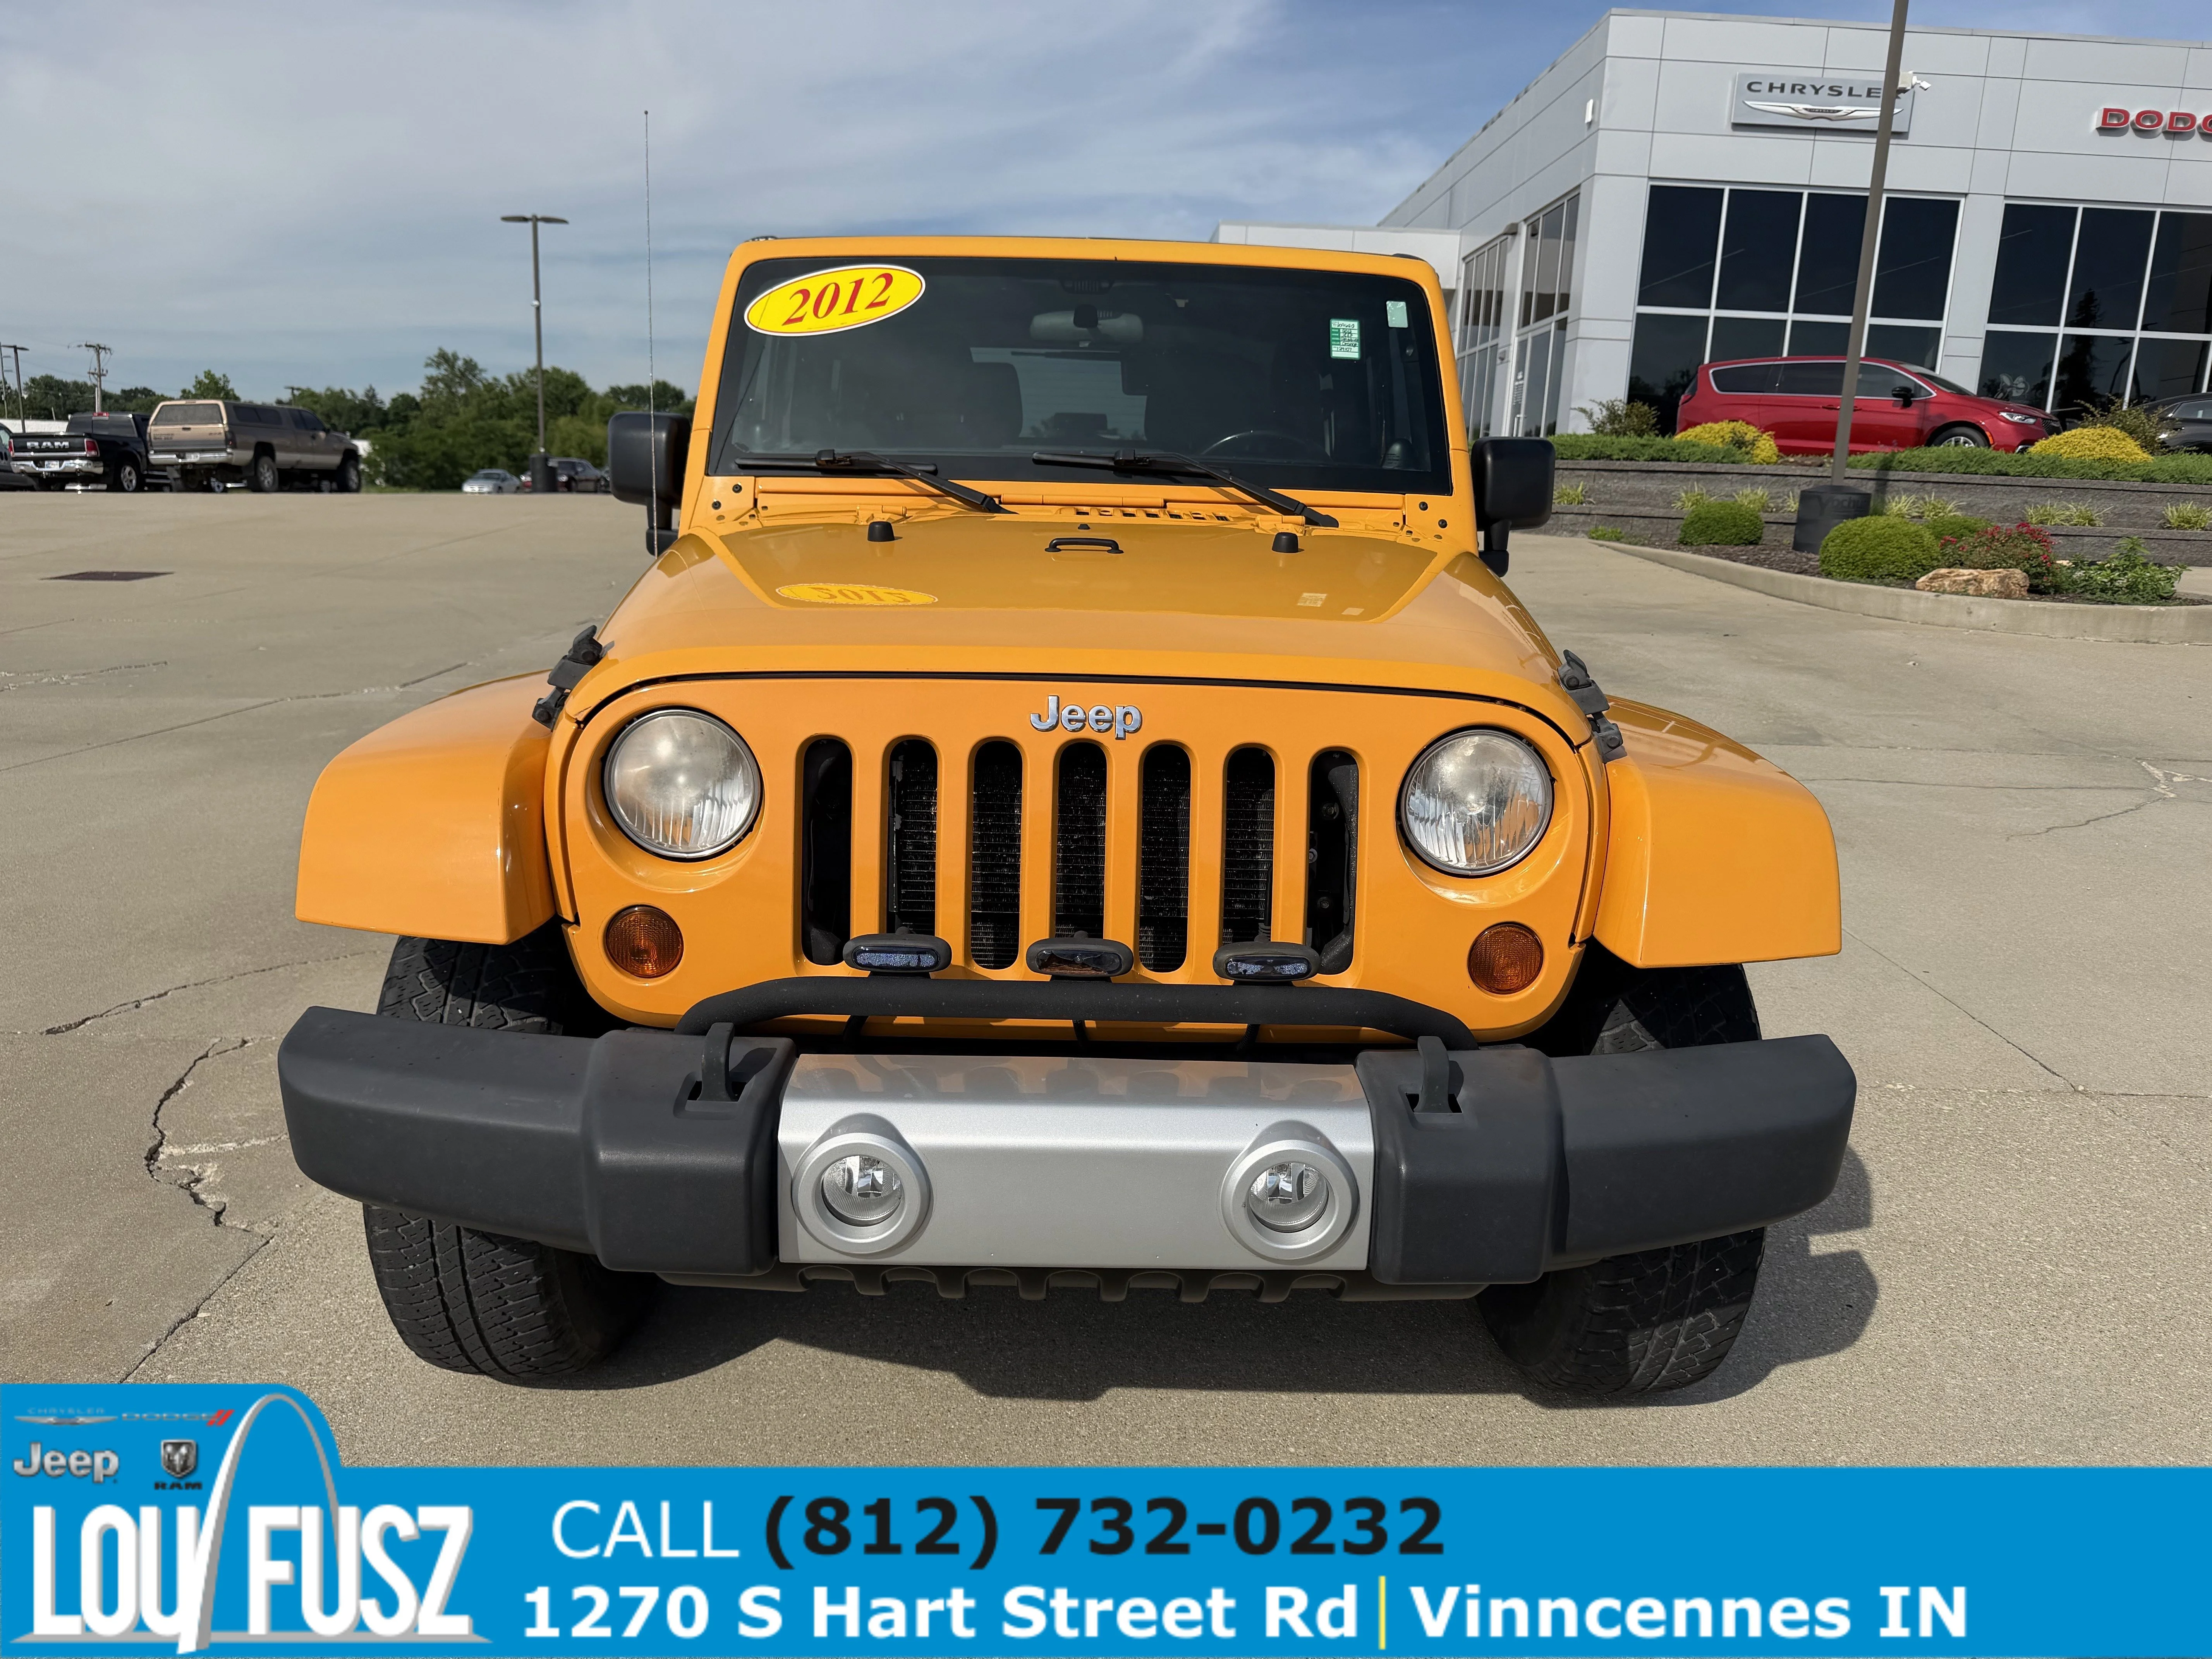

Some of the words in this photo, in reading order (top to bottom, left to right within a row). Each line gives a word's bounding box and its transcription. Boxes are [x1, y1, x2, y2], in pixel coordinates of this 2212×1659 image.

[1747, 81, 1901, 99] CHRYSLE
[781, 273, 893, 327] 2012
[1030, 695, 1142, 740] Jeep
